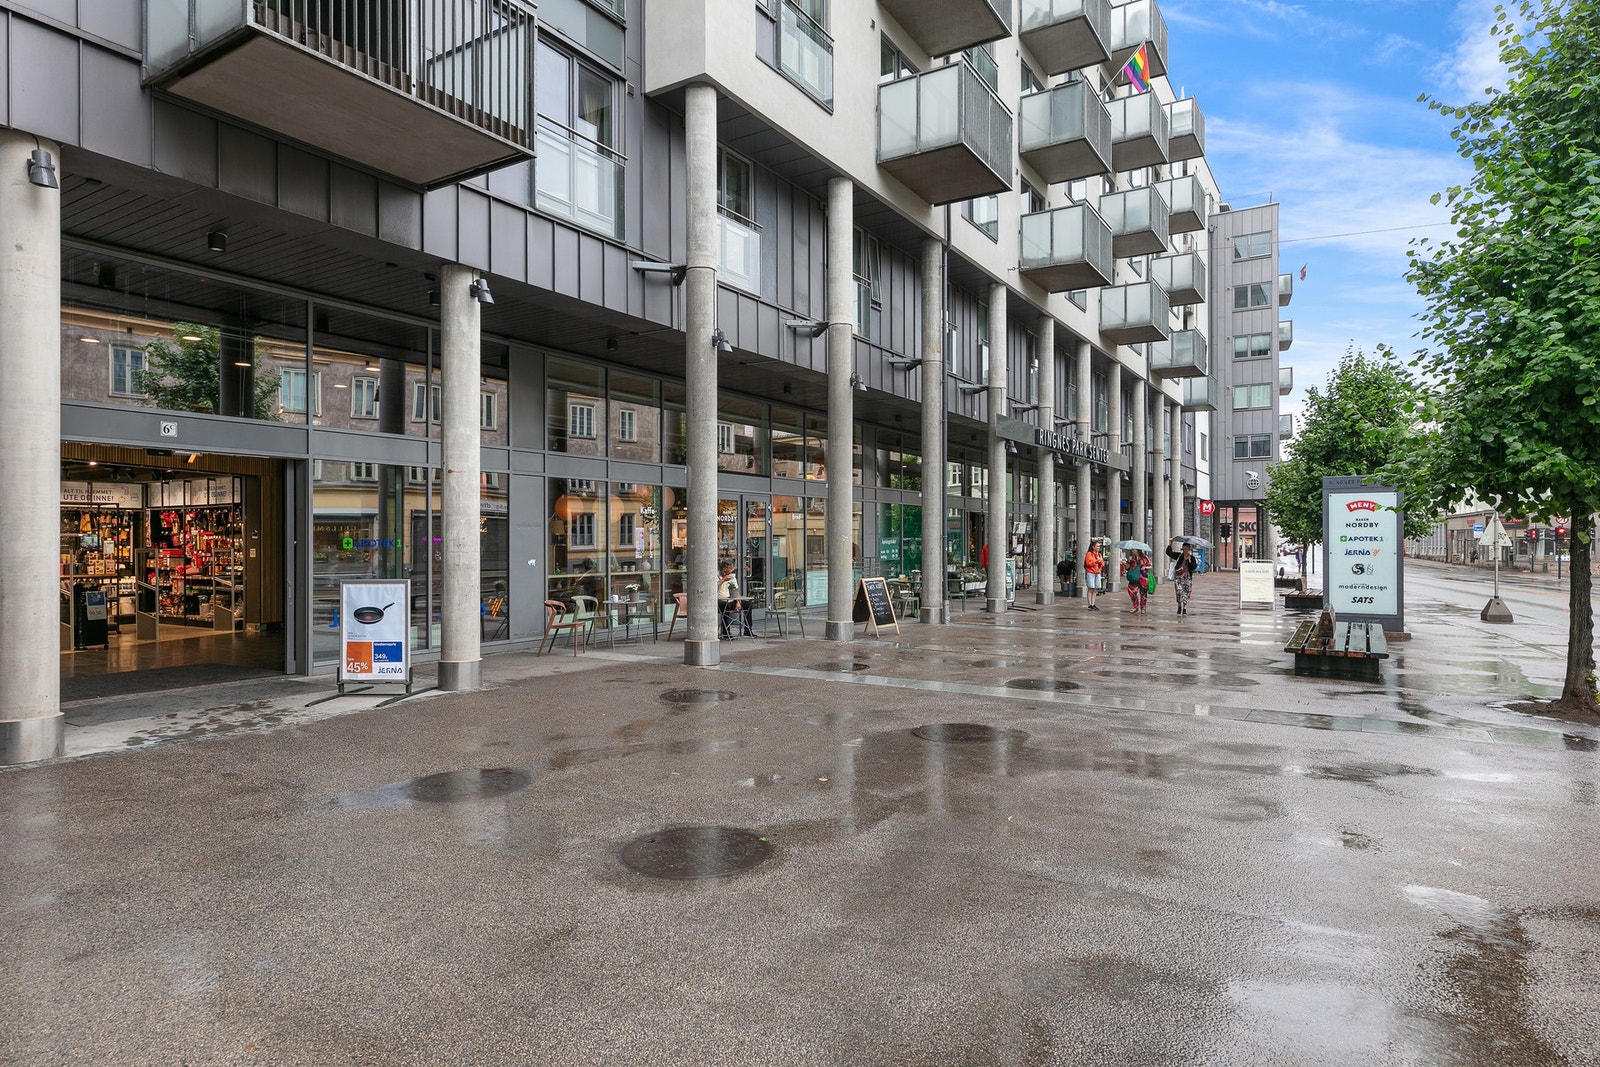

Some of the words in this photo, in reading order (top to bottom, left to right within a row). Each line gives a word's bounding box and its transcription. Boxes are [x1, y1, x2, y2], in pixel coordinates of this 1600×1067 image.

[1039, 428, 1070, 453] RINGNES
[1071, 438, 1088, 458] PARK
[354, 538, 395, 548] APOTEK
[396, 537, 402, 548] 1
[1351, 596, 1375, 604] SATS
[347, 662, 369, 673] 45%
